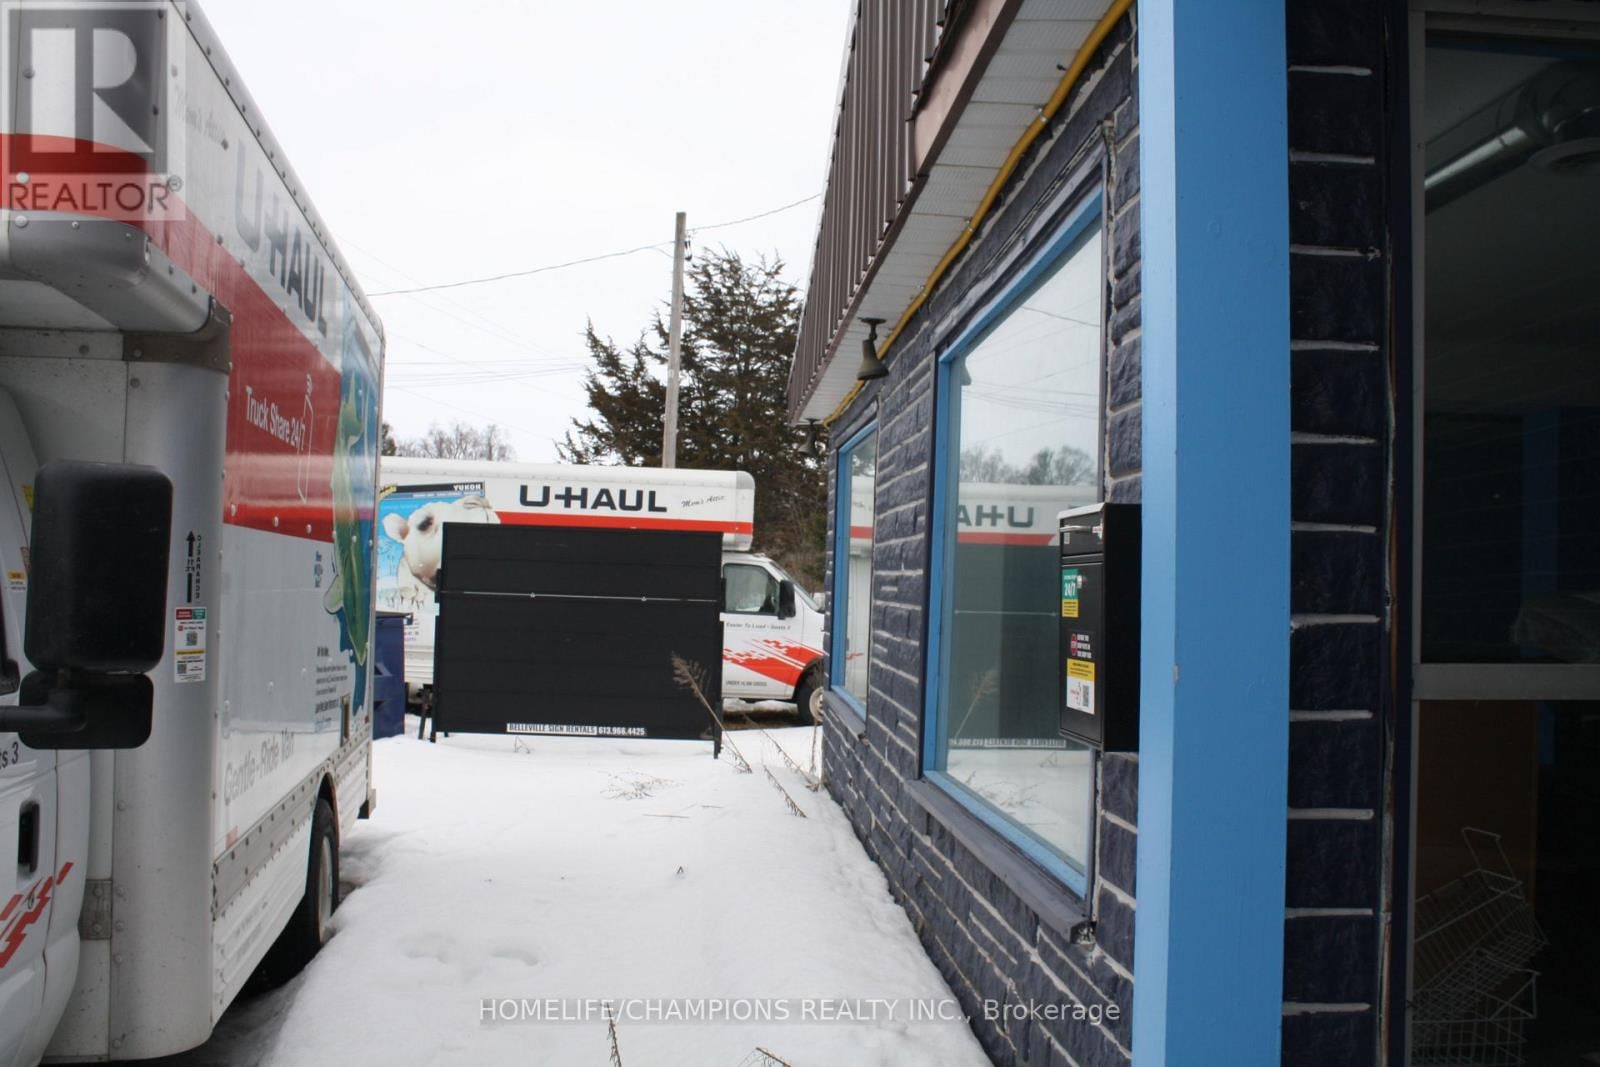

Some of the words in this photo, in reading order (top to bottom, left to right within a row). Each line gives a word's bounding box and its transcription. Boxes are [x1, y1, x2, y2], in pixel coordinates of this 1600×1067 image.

[246, 385, 269, 432] Truck
[270, 402, 289, 444] Share
[453, 483, 481, 491] YUKON
[508, 723, 545, 732] BELLEVILLE
[547, 724, 564, 732] SIGN
[565, 725, 596, 734] RENTALS
[11, 741, 19, 765] 3
